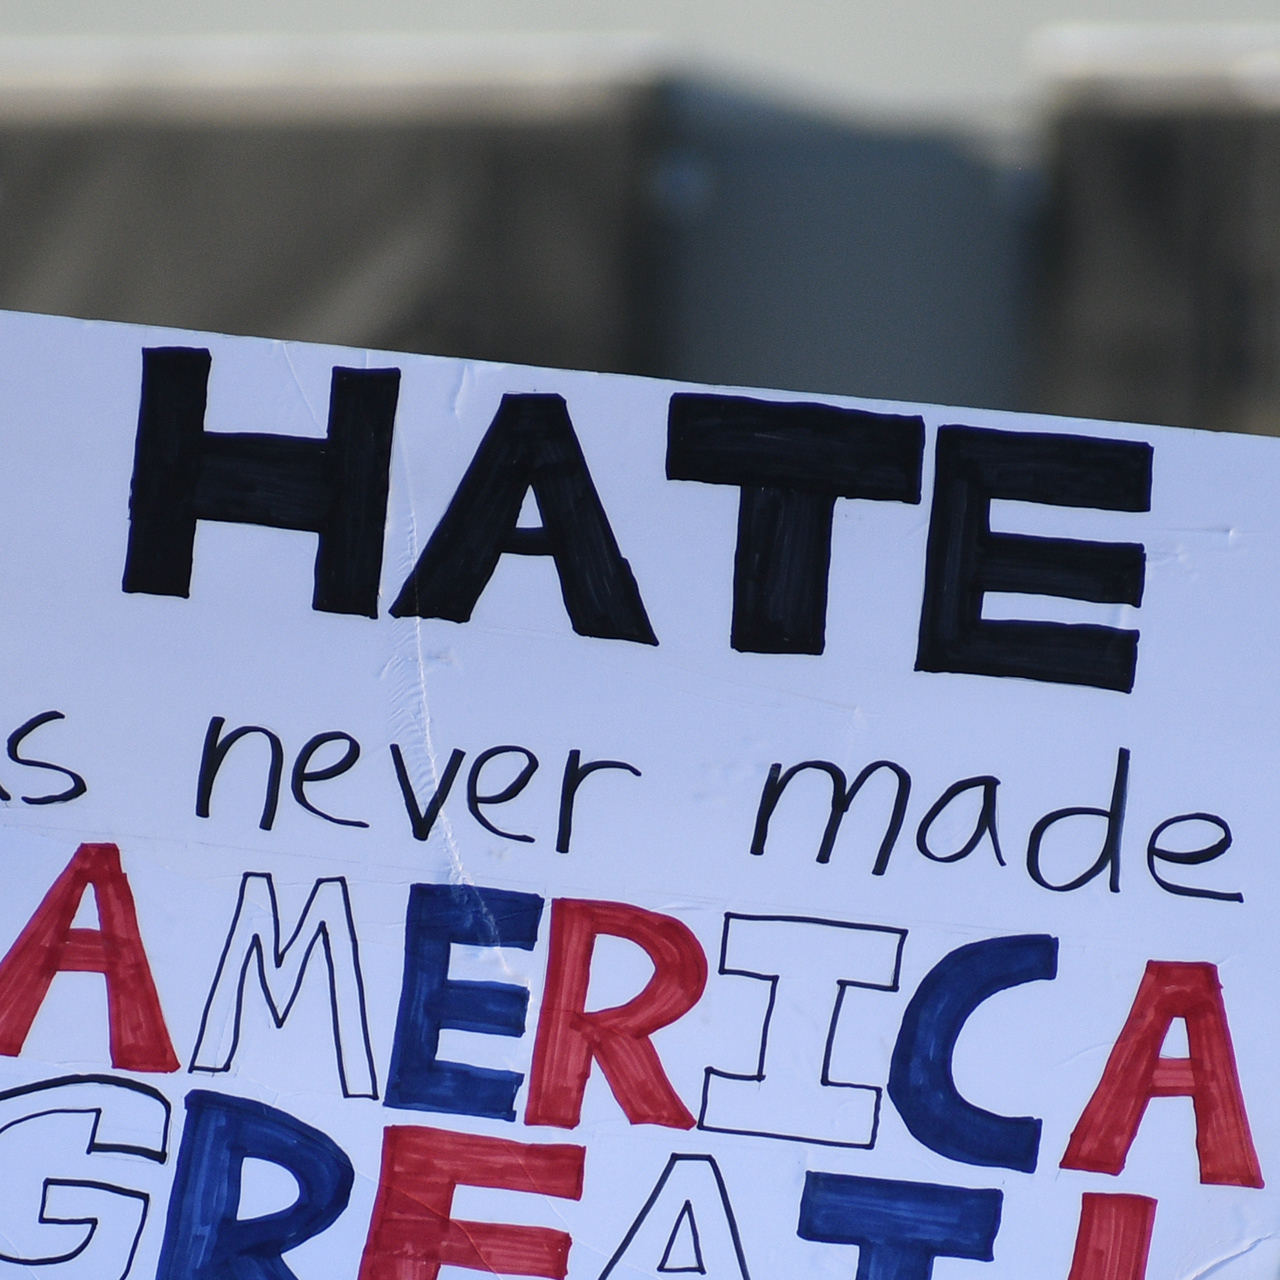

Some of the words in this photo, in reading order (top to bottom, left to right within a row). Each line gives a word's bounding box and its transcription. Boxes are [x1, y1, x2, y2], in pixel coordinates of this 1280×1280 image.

[121, 346, 1154, 694] HATE
[196, 715, 642, 855] never
[750, 746, 1244, 904] made
